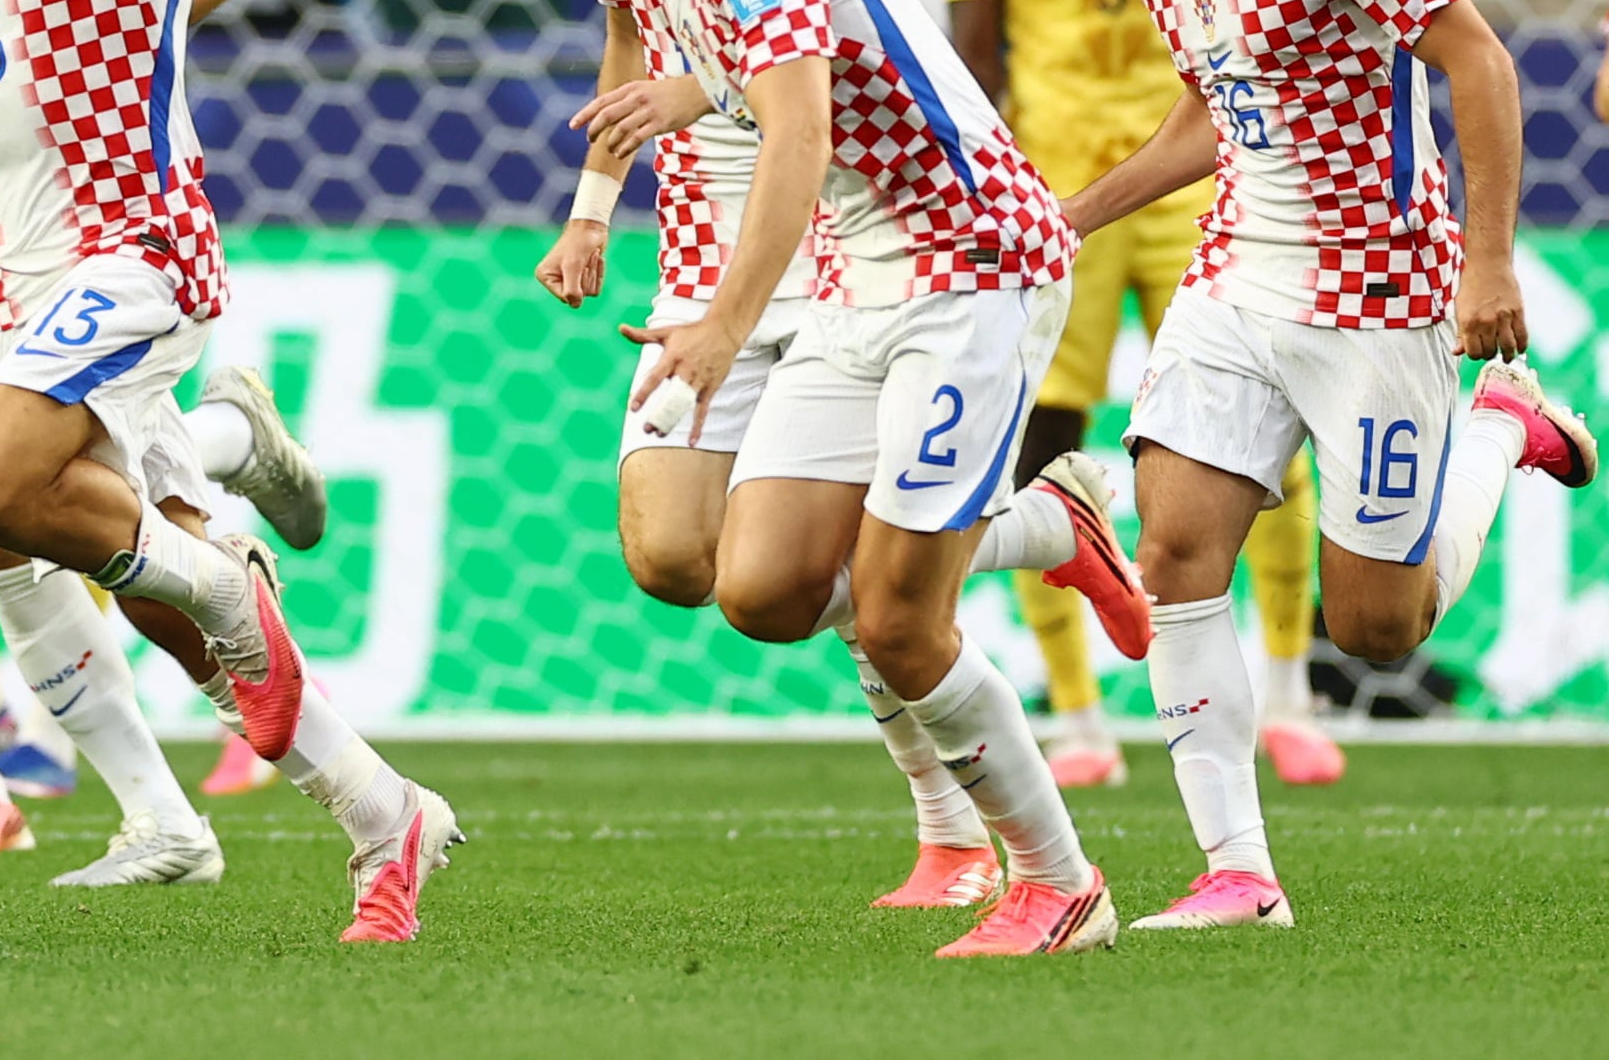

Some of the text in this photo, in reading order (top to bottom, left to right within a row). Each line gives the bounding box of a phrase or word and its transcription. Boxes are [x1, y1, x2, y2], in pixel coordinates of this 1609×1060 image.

[1215, 80, 1271, 151] 16
[32, 287, 117, 345] 13
[918, 384, 964, 467] 2
[1358, 418, 1418, 498] 16
